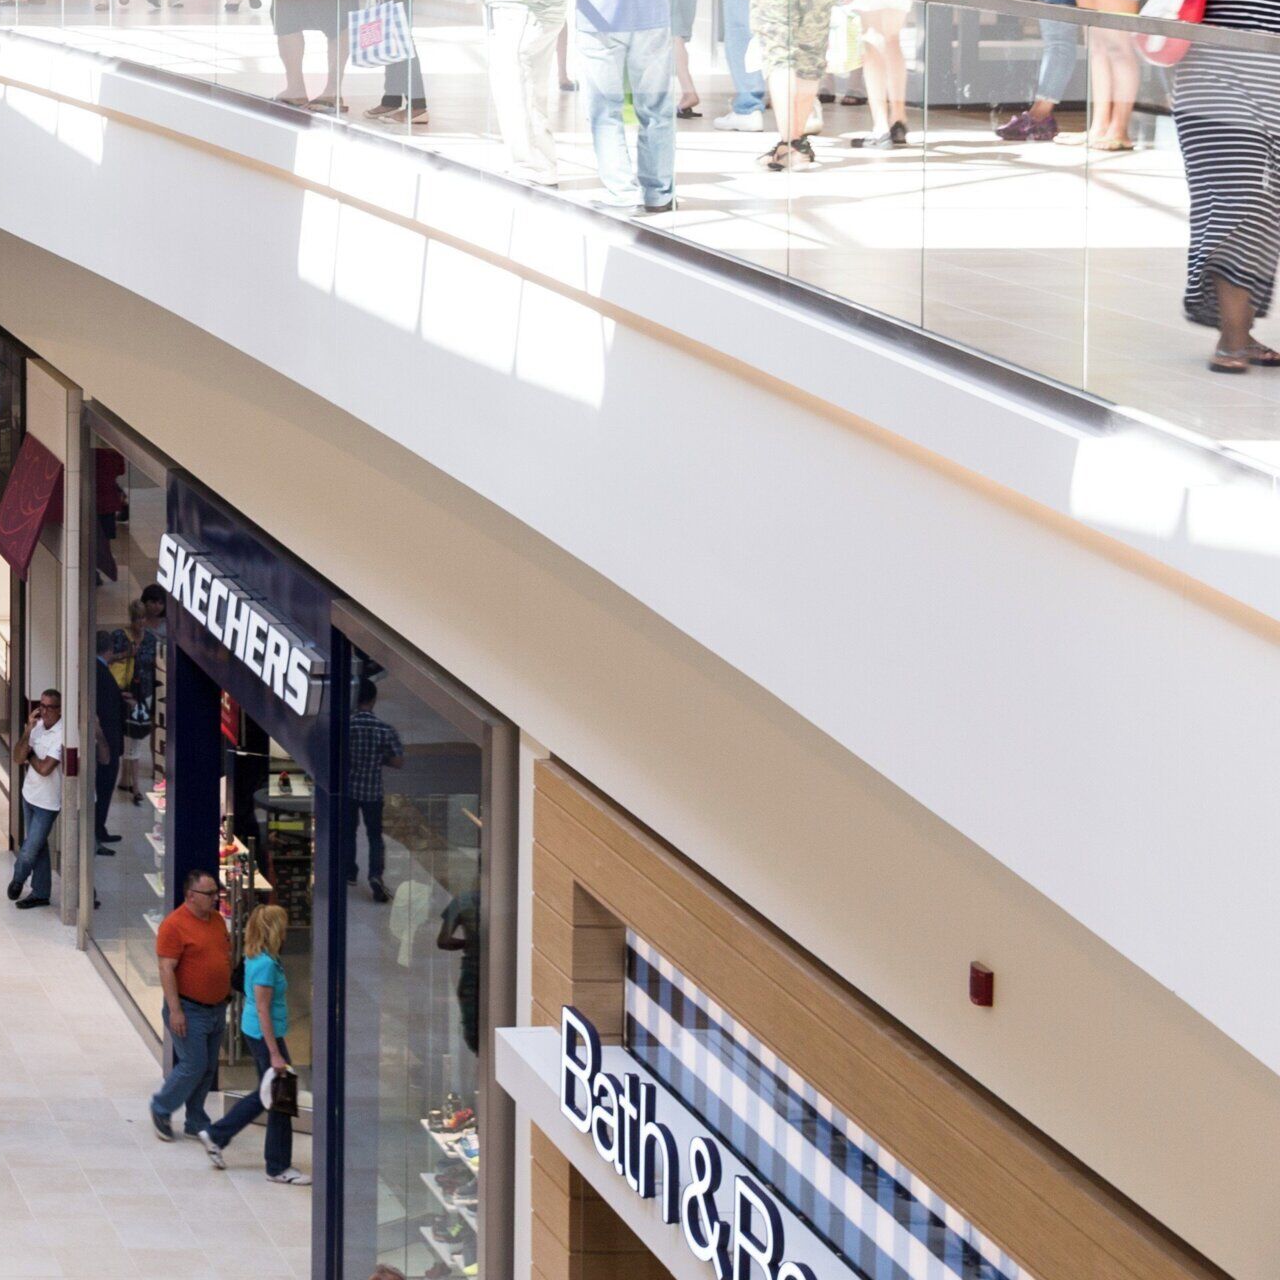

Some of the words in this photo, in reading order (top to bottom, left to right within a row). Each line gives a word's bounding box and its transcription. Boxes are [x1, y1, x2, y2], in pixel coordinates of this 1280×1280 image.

[156, 532, 313, 717] SKECHERS
[560, 1005, 680, 1224] Bath
[682, 1136, 731, 1280] &
